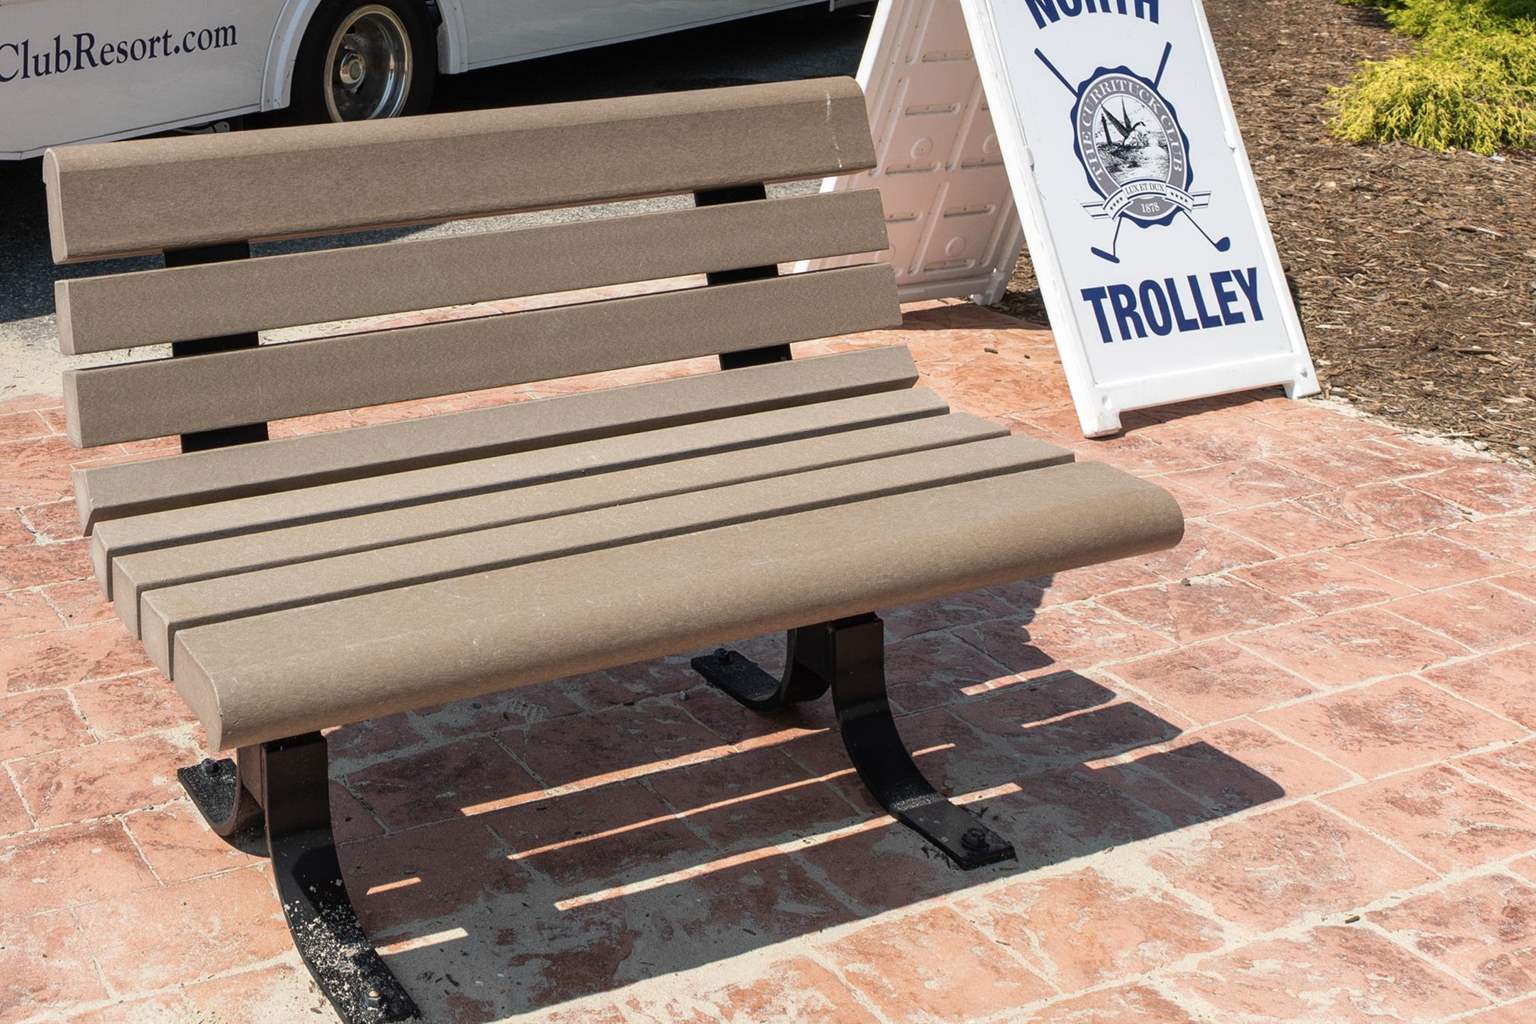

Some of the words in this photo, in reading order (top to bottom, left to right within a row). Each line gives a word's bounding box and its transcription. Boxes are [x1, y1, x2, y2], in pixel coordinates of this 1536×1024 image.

[1082, 79, 1162, 127] CURRITUCK
[1081, 131, 1103, 181] THE
[1162, 114, 1183, 172] CLUB
[1080, 267, 1264, 344] TROLLEY
